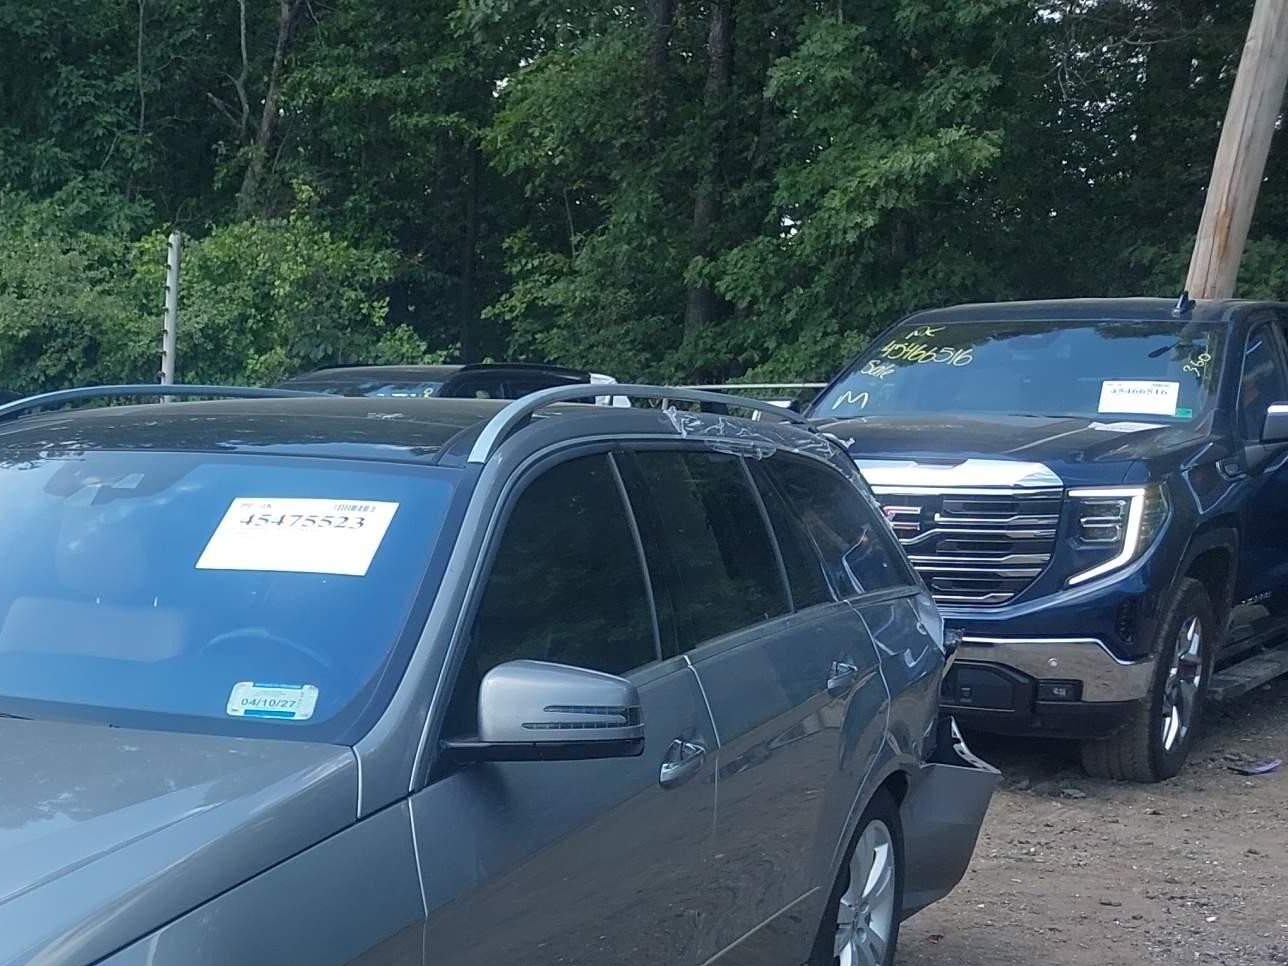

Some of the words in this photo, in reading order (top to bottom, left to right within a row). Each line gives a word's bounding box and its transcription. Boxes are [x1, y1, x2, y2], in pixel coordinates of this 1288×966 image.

[881, 340, 974, 366] 45466516
[1183, 353, 1211, 377] 360
[832, 390, 869, 410] M
[239, 513, 366, 529] 45475523
[240, 698, 297, 708] 04/10/27
